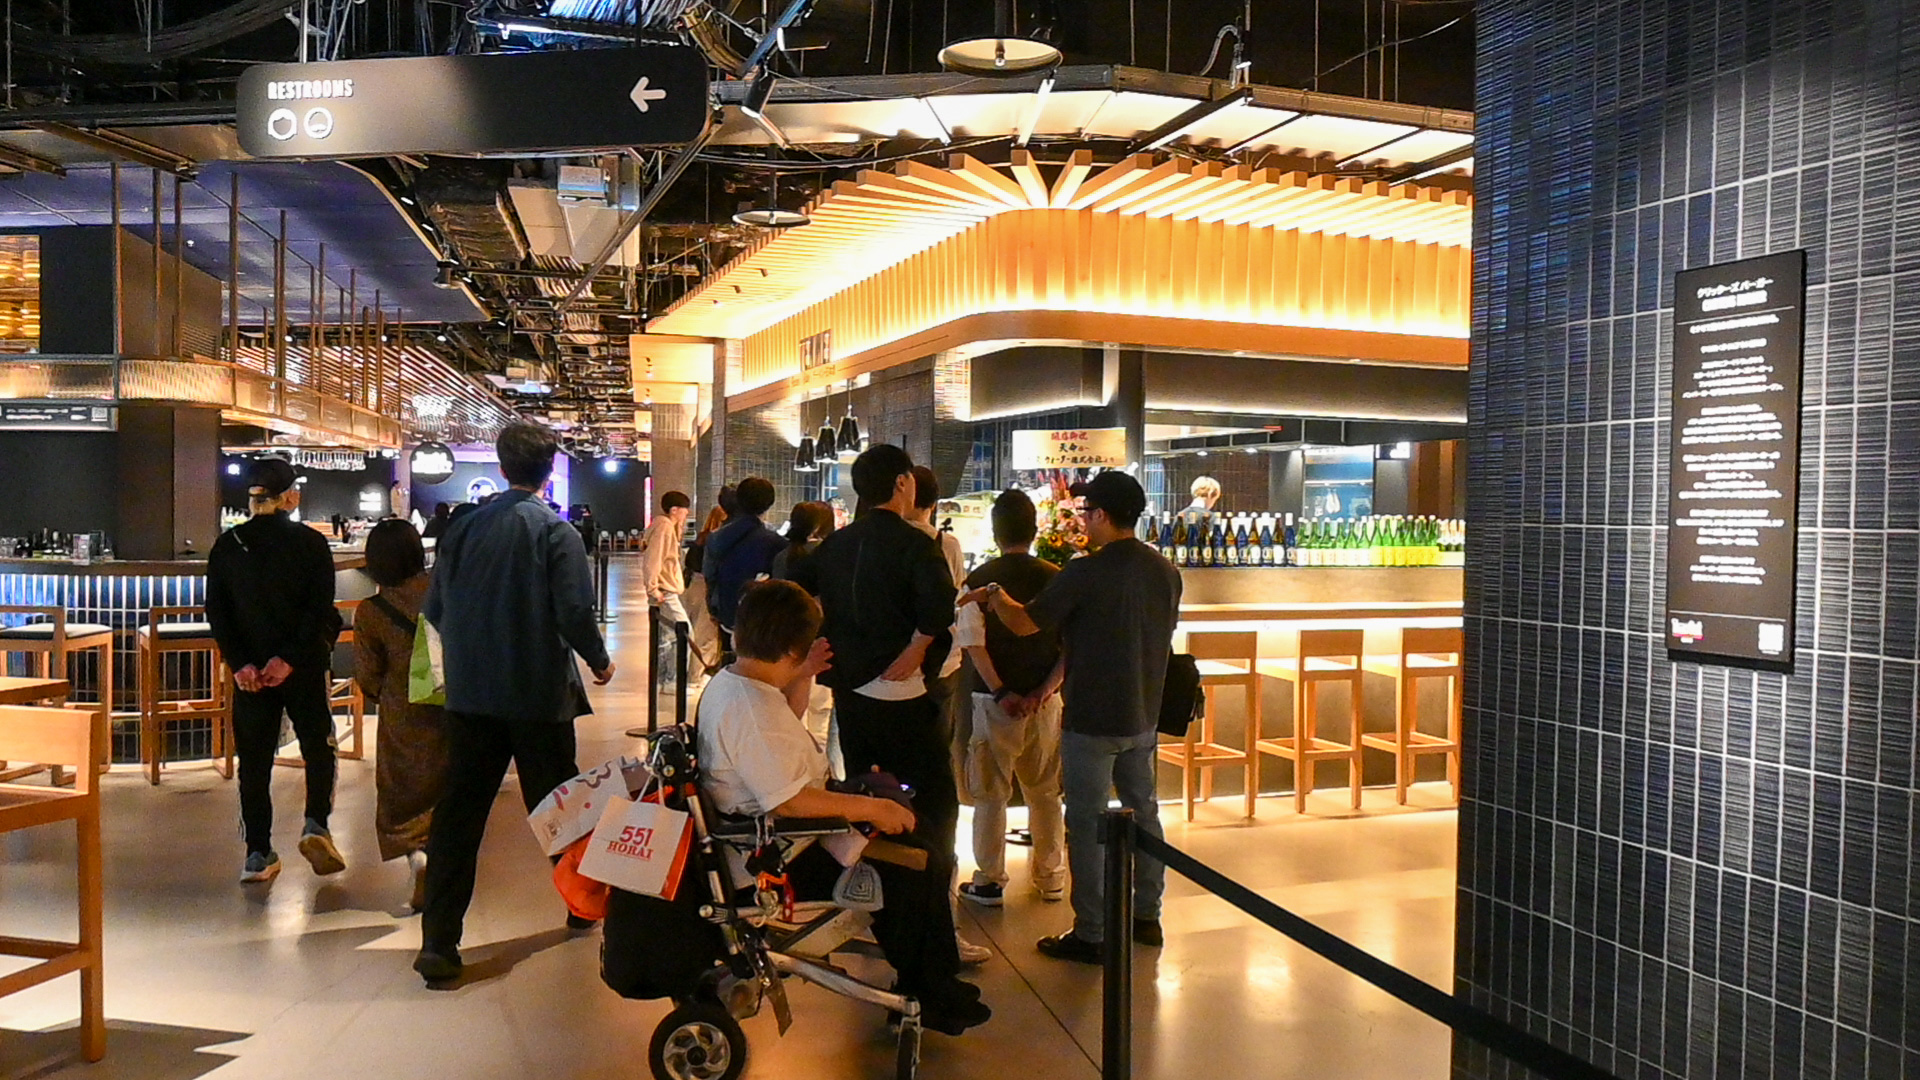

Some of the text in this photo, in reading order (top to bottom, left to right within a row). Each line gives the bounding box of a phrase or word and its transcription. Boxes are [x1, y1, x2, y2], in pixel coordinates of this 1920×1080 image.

[267, 79, 353, 100] RESTROOMS
[619, 825, 654, 847] 551
[607, 840, 654, 859] HORAI
